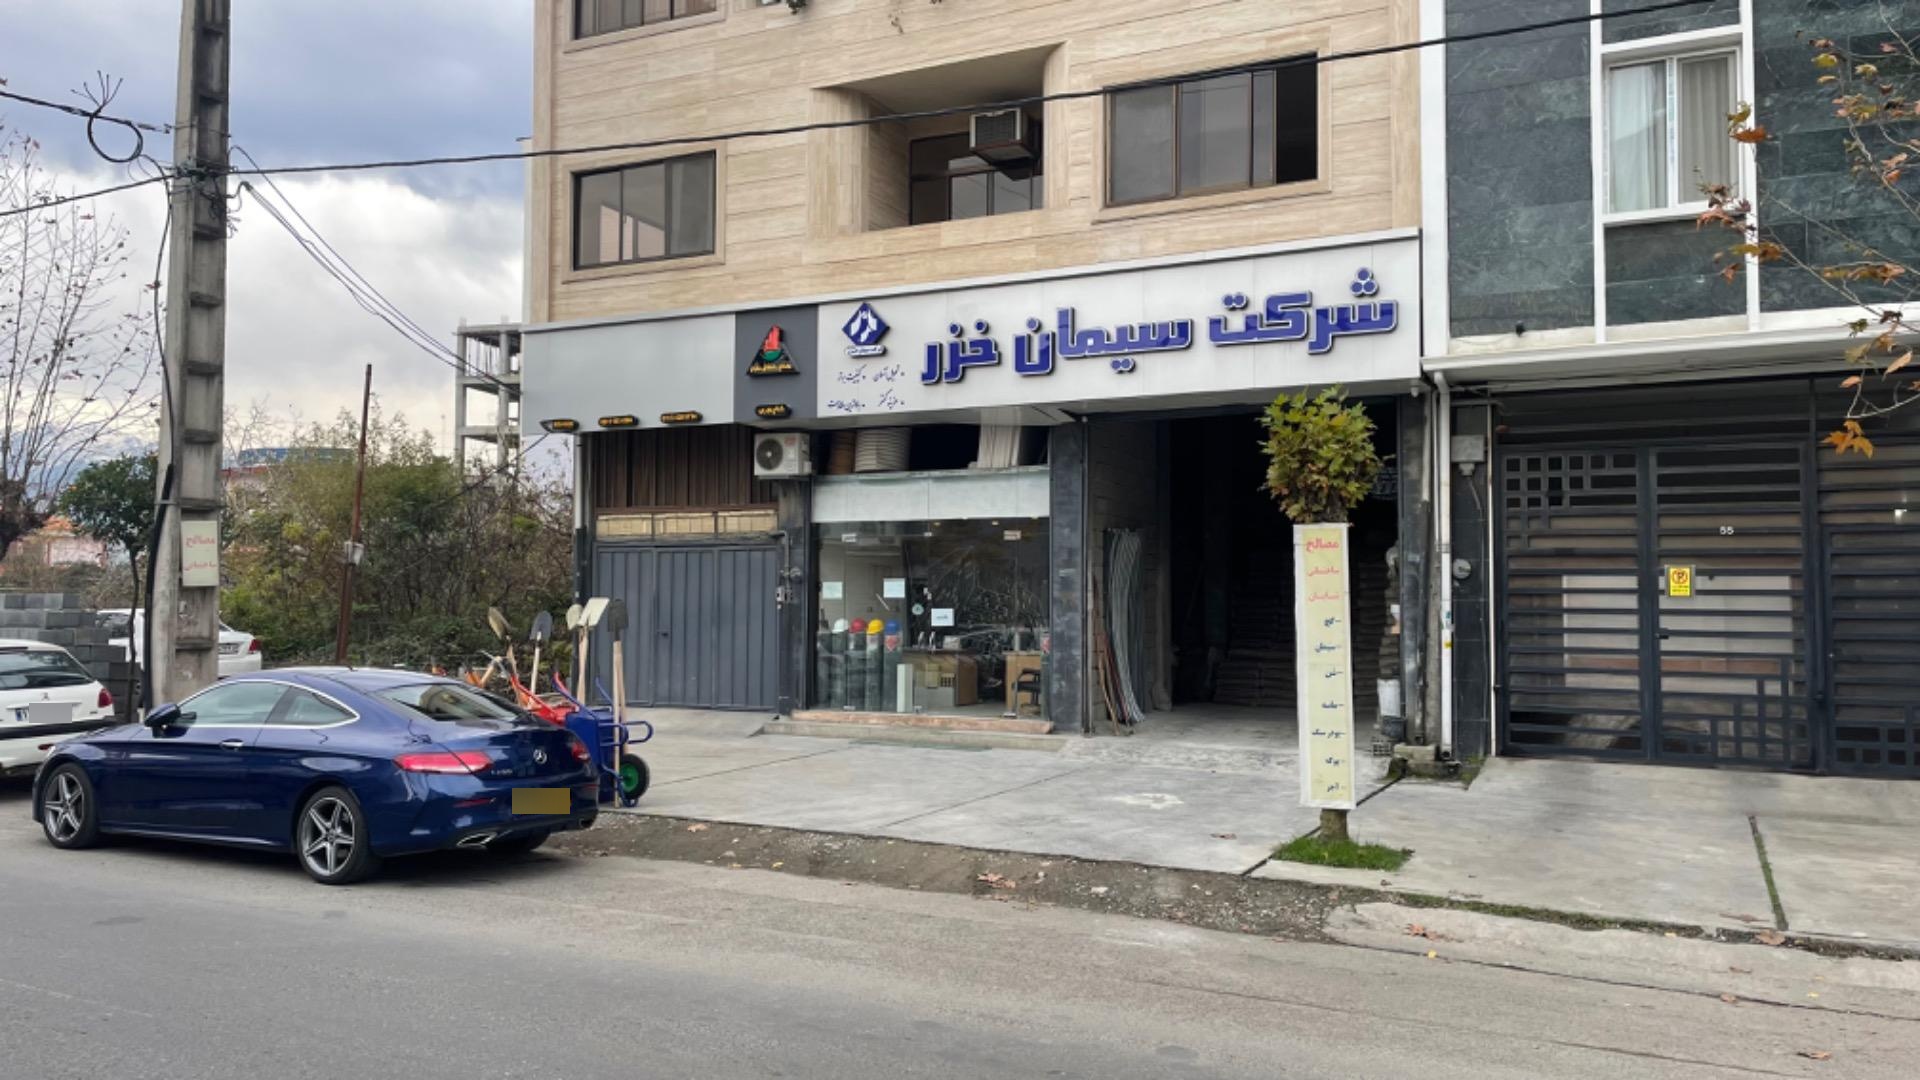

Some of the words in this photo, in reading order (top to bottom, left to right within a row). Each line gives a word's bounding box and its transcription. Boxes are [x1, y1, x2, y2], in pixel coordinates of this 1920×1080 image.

[1013, 307, 1193, 375] سیمان
[1208, 267, 1399, 355] شرکت
[921, 319, 1002, 385] خزر
[1305, 537, 1339, 553] مصالح
[1720, 526, 1735, 535] 55
